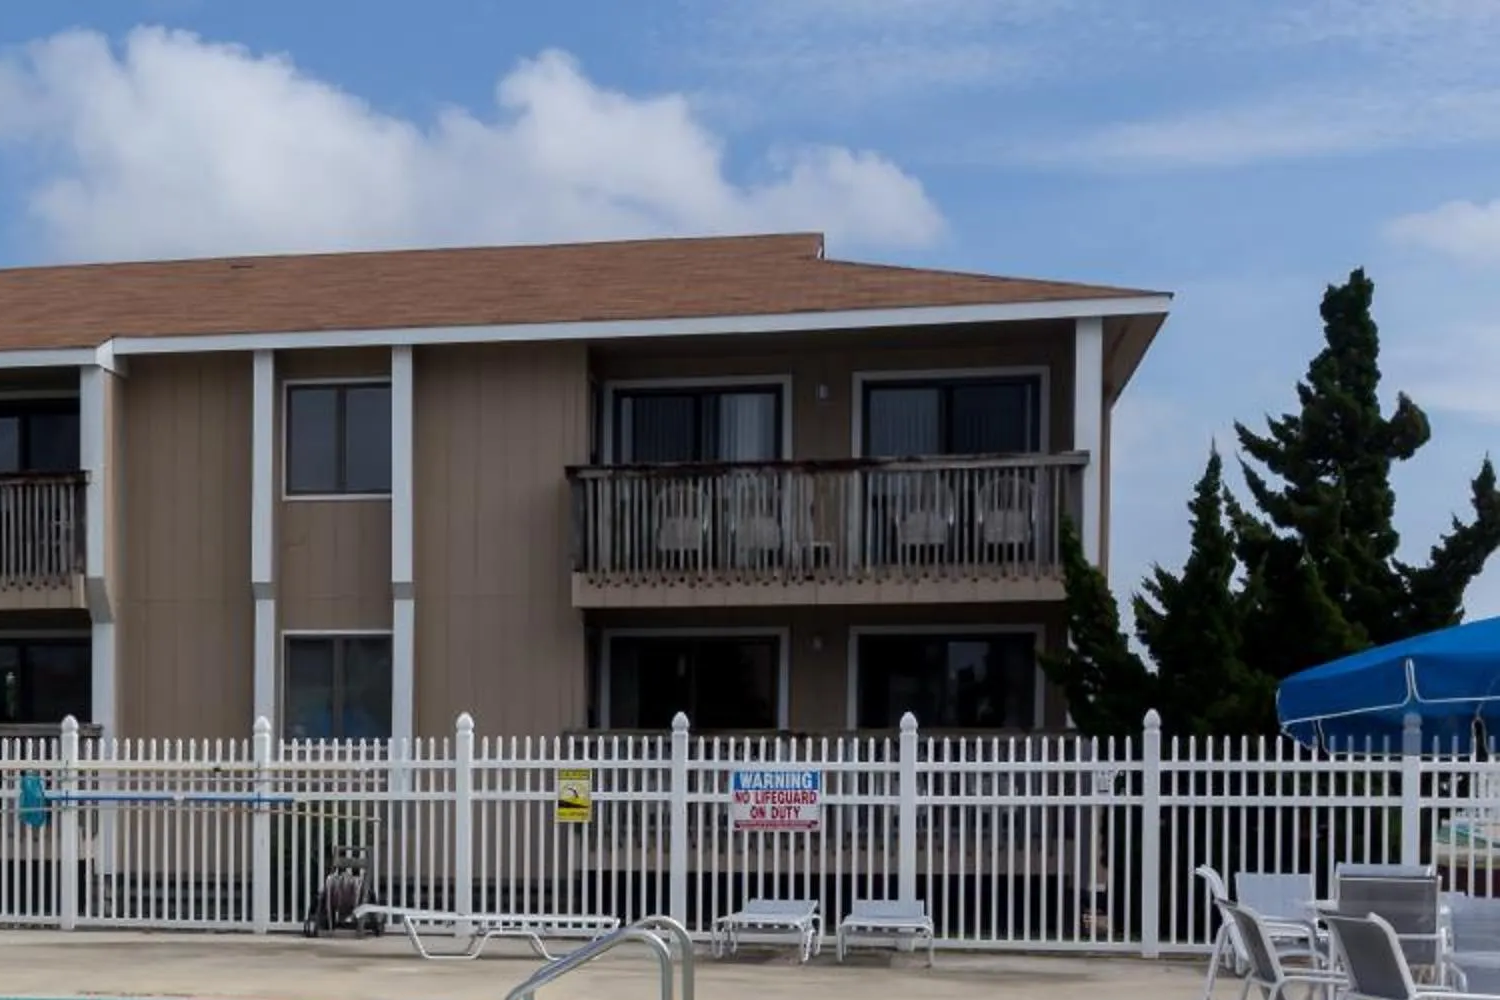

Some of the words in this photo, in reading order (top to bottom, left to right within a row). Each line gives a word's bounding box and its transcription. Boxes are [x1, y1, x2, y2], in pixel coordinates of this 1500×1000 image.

[740, 772, 812, 789] WARNING
[735, 791, 750, 804] NO
[755, 791, 817, 804] LIFEGUARD
[750, 805, 766, 818] ON
[771, 806, 800, 818] DUTY
